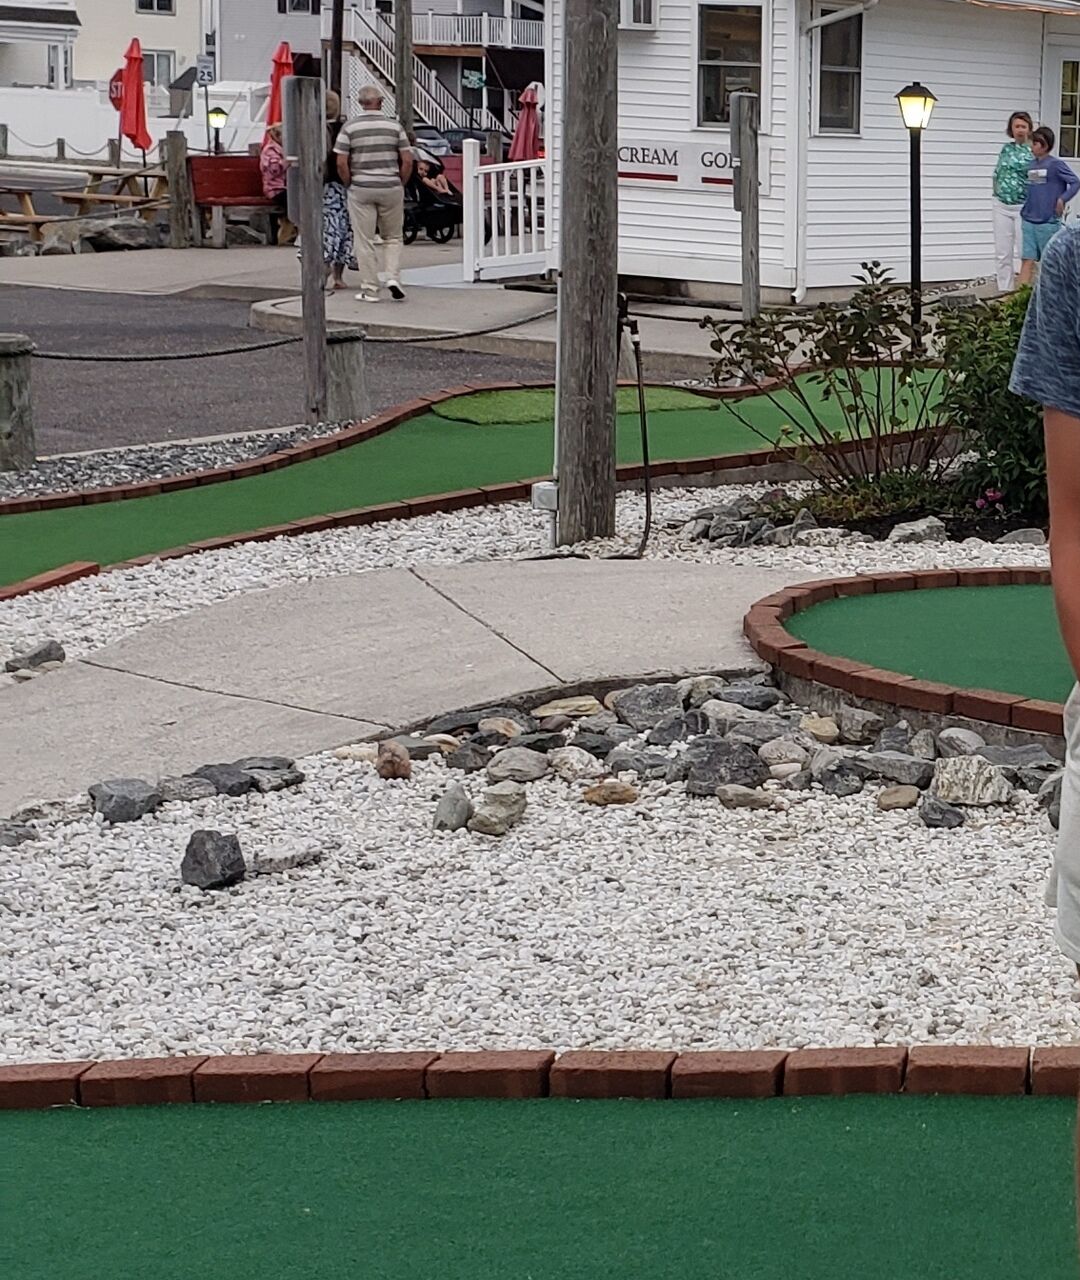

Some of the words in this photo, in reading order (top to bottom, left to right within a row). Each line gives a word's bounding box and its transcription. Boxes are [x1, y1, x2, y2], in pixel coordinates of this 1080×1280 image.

[200, 70, 213, 82] 25
[110, 81, 124, 98] ST
[618, 146, 678, 166] CREAM
[701, 151, 736, 168] GOL
